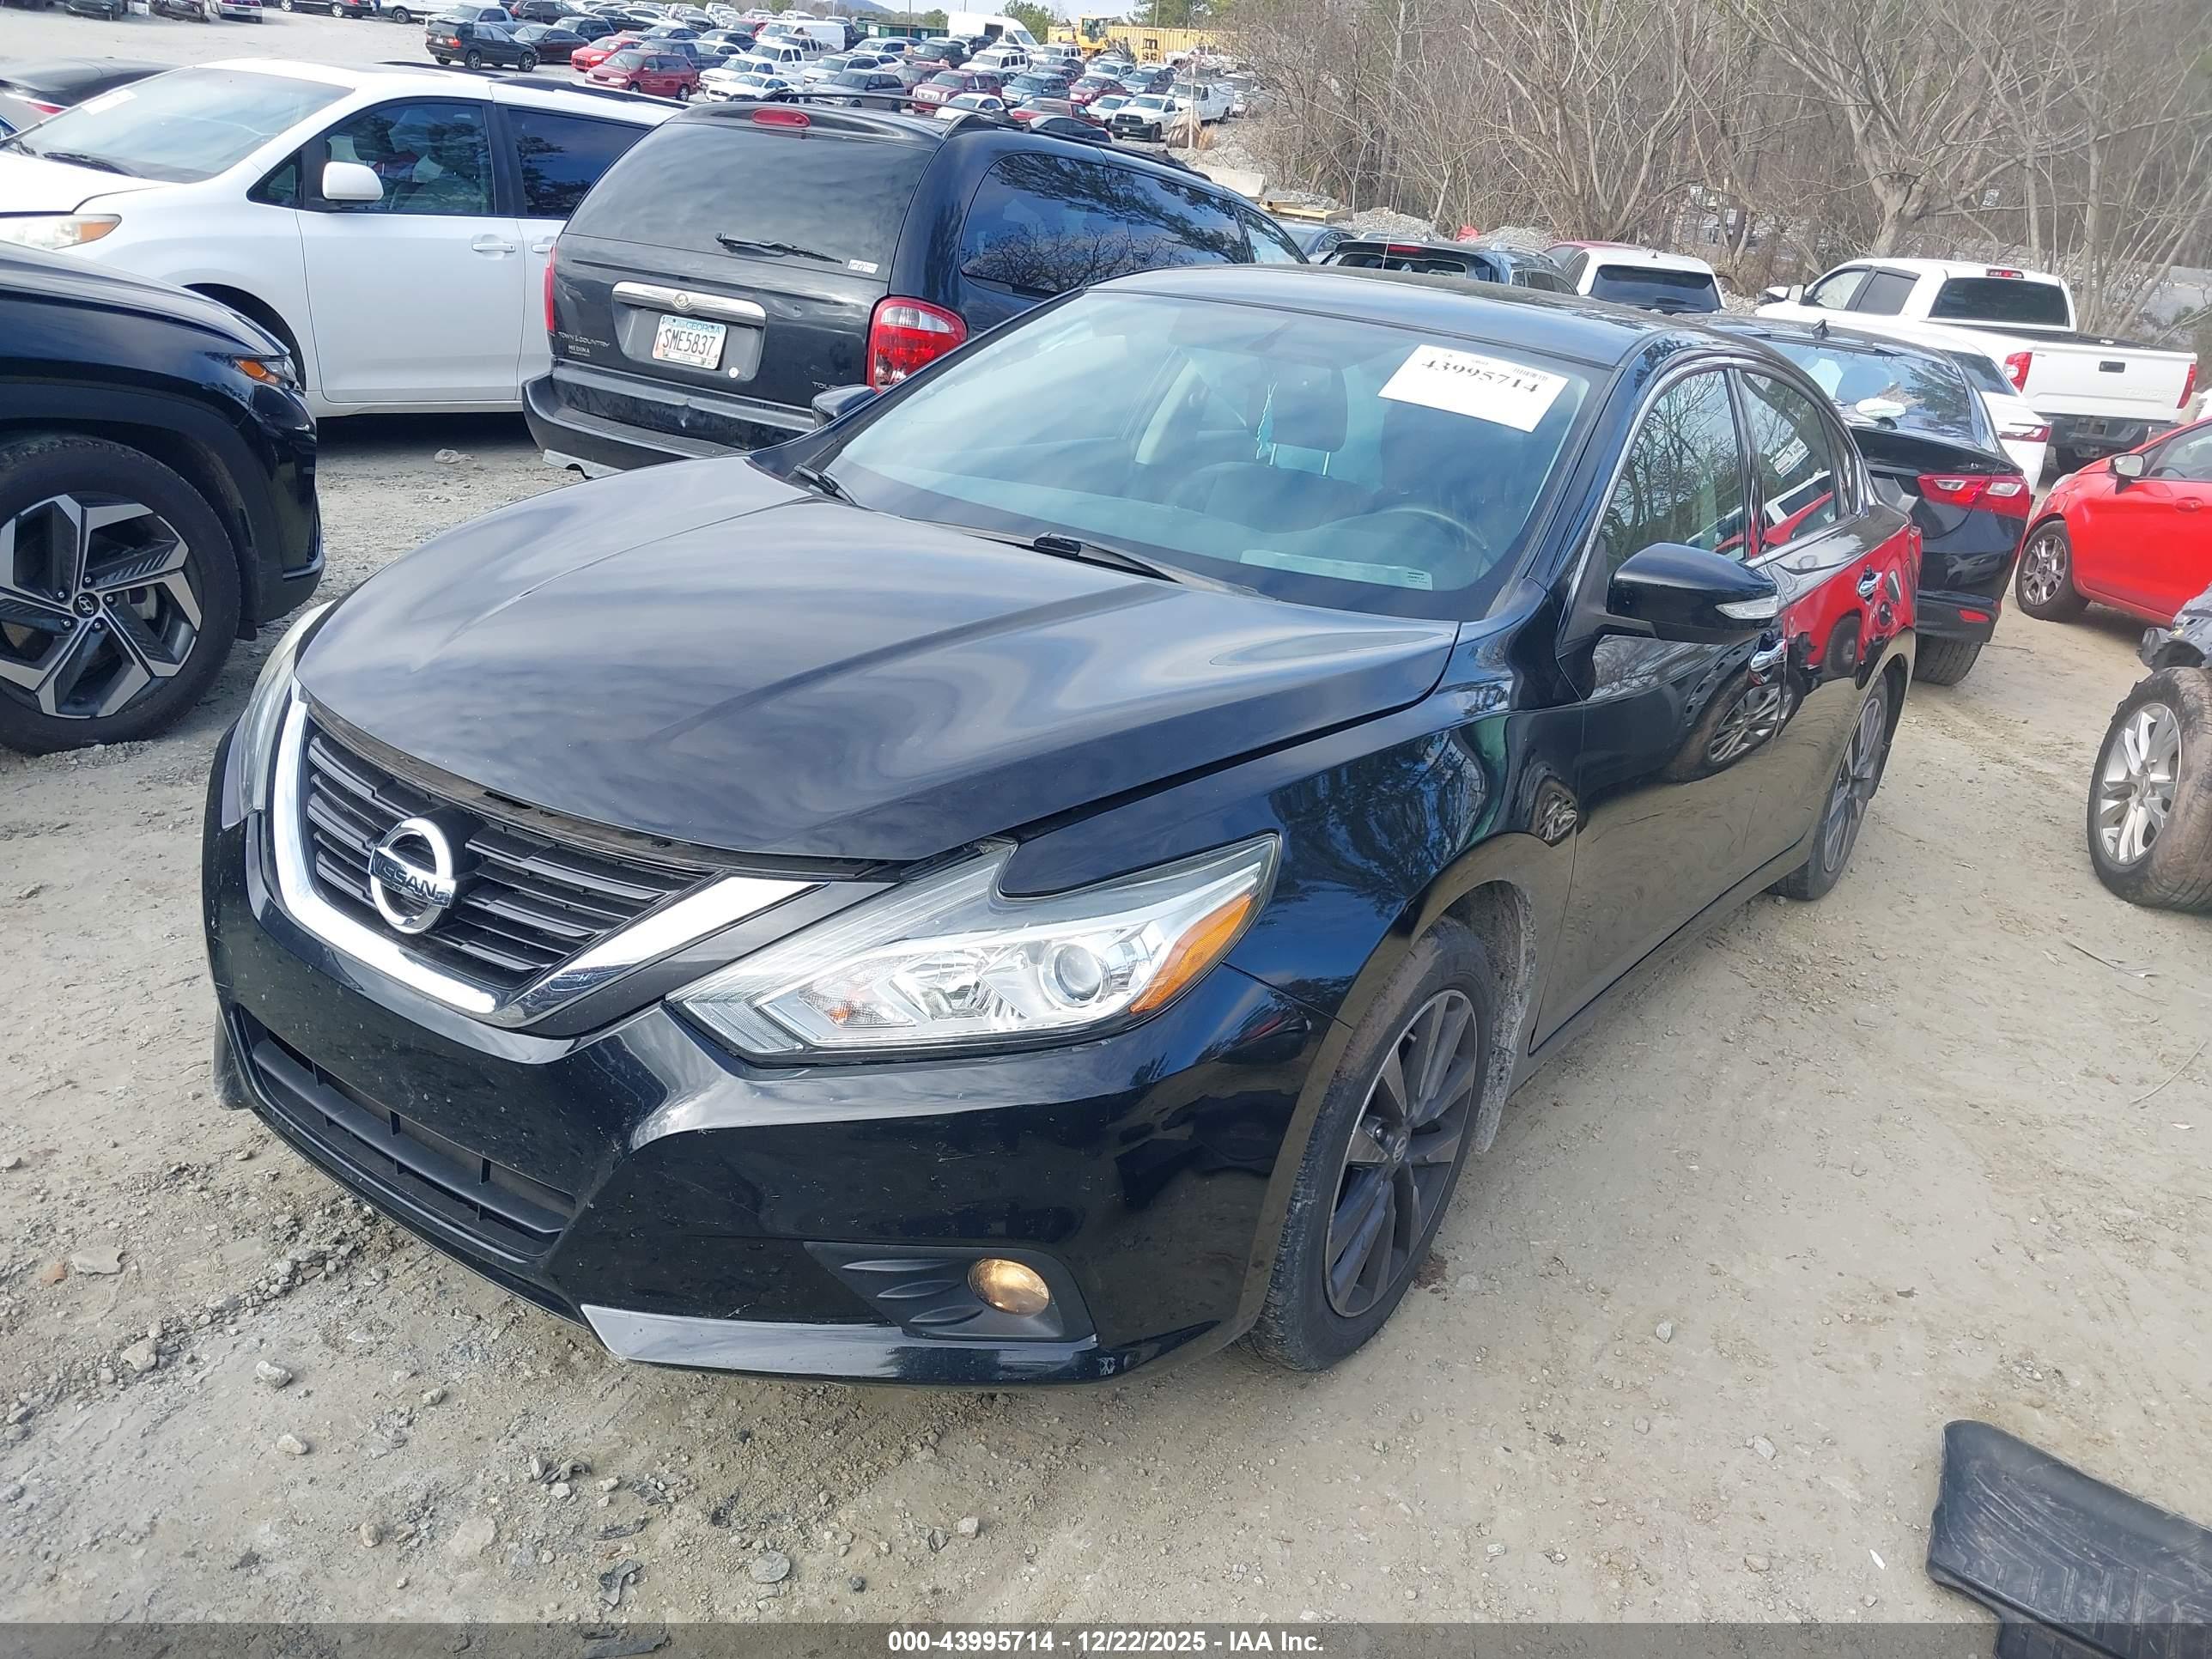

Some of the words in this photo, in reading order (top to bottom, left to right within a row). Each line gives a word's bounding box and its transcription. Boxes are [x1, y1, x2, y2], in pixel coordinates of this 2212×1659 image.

[685, 321, 720, 334] GEORGIA
[568, 344, 590, 354] MEDINA
[662, 328, 716, 356] SME5837
[1422, 359, 1539, 392] 43995714
[373, 856, 437, 898] NISSAN
